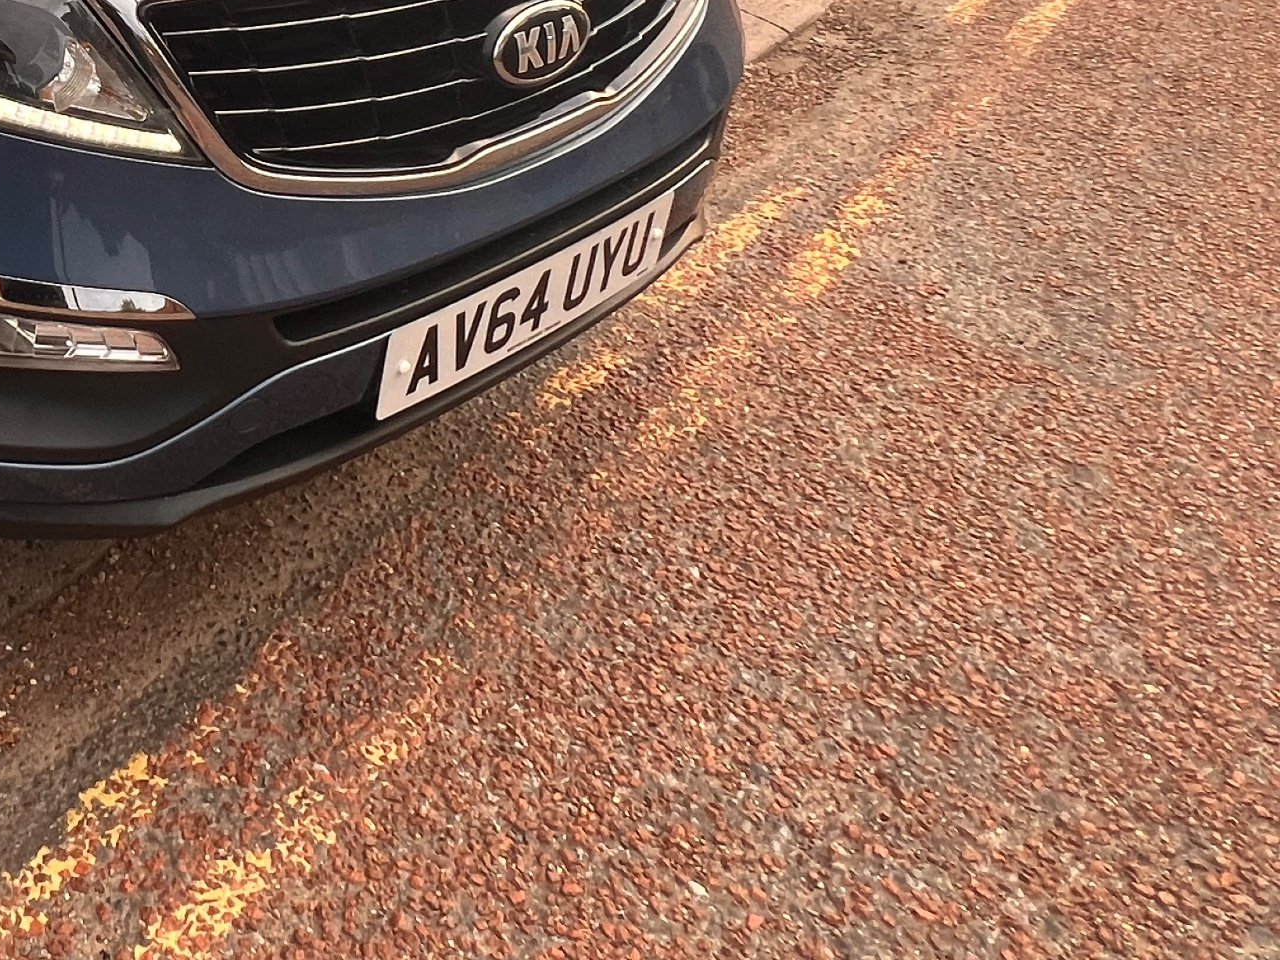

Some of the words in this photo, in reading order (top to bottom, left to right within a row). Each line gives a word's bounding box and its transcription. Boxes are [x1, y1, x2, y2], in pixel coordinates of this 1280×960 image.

[514, 14, 581, 74] KIA
[405, 270, 551, 396] AV64
[562, 211, 655, 312] UYU
